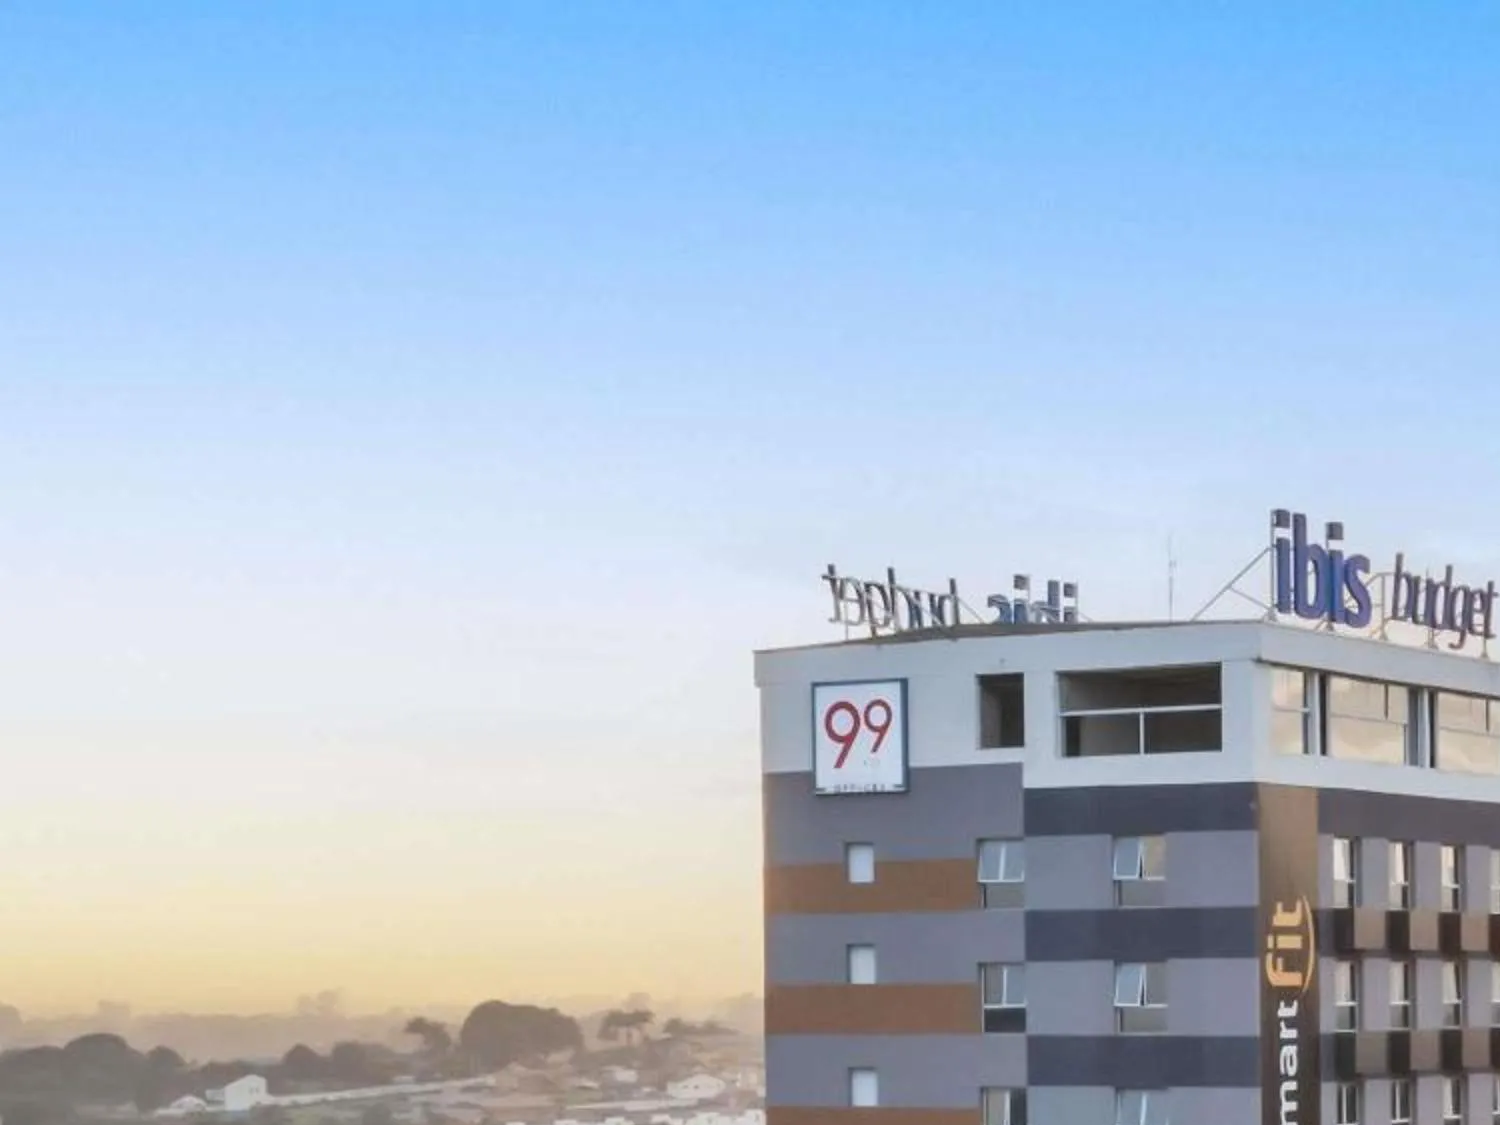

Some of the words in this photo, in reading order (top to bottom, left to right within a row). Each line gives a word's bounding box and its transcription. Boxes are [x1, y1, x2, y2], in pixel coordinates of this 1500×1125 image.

[1271, 509, 1372, 628] ibis
[1391, 552, 1499, 649] budget
[824, 699, 893, 769] 99
[1265, 901, 1304, 987] fit
